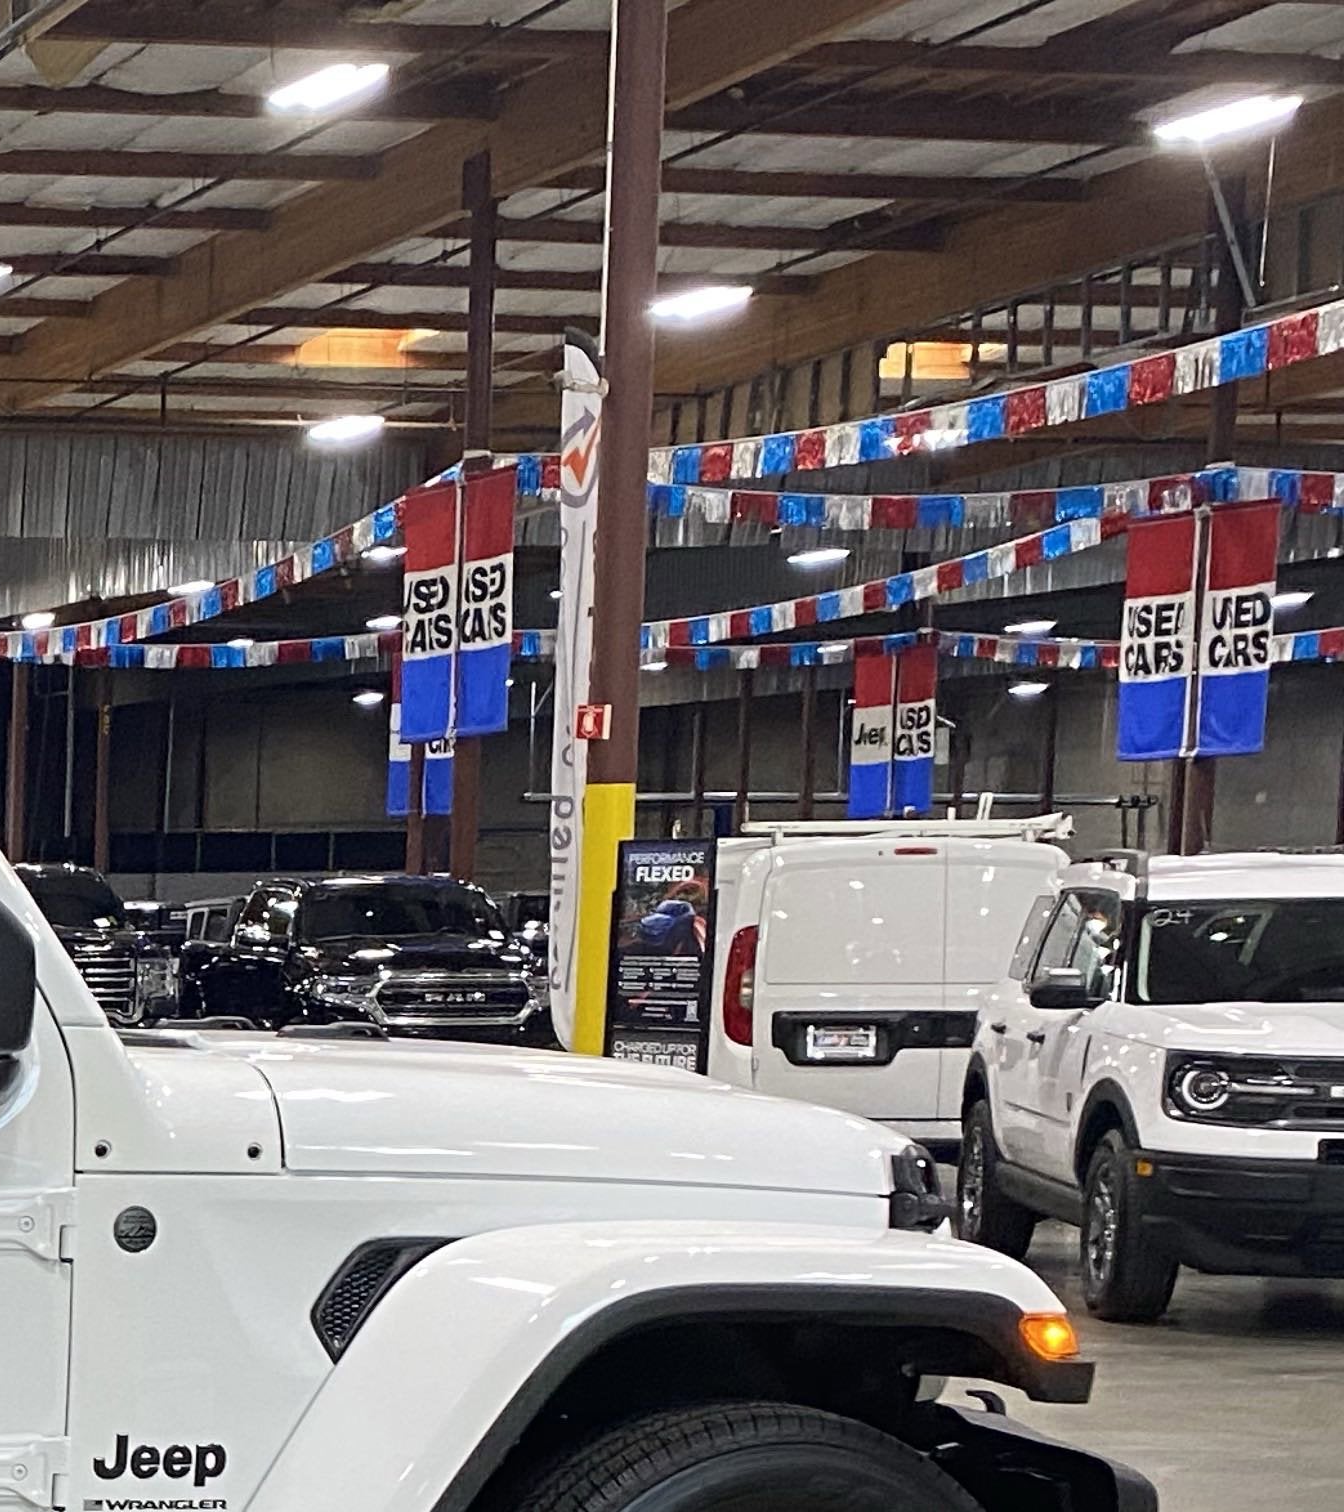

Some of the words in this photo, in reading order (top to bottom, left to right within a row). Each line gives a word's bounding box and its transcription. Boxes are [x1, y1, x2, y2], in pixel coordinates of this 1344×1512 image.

[629, 852, 705, 864] PERFORMANCE
[636, 865, 695, 882] FLEXED
[93, 1434, 226, 1487] Jeep
[106, 1499, 227, 1510] WRANGLER
